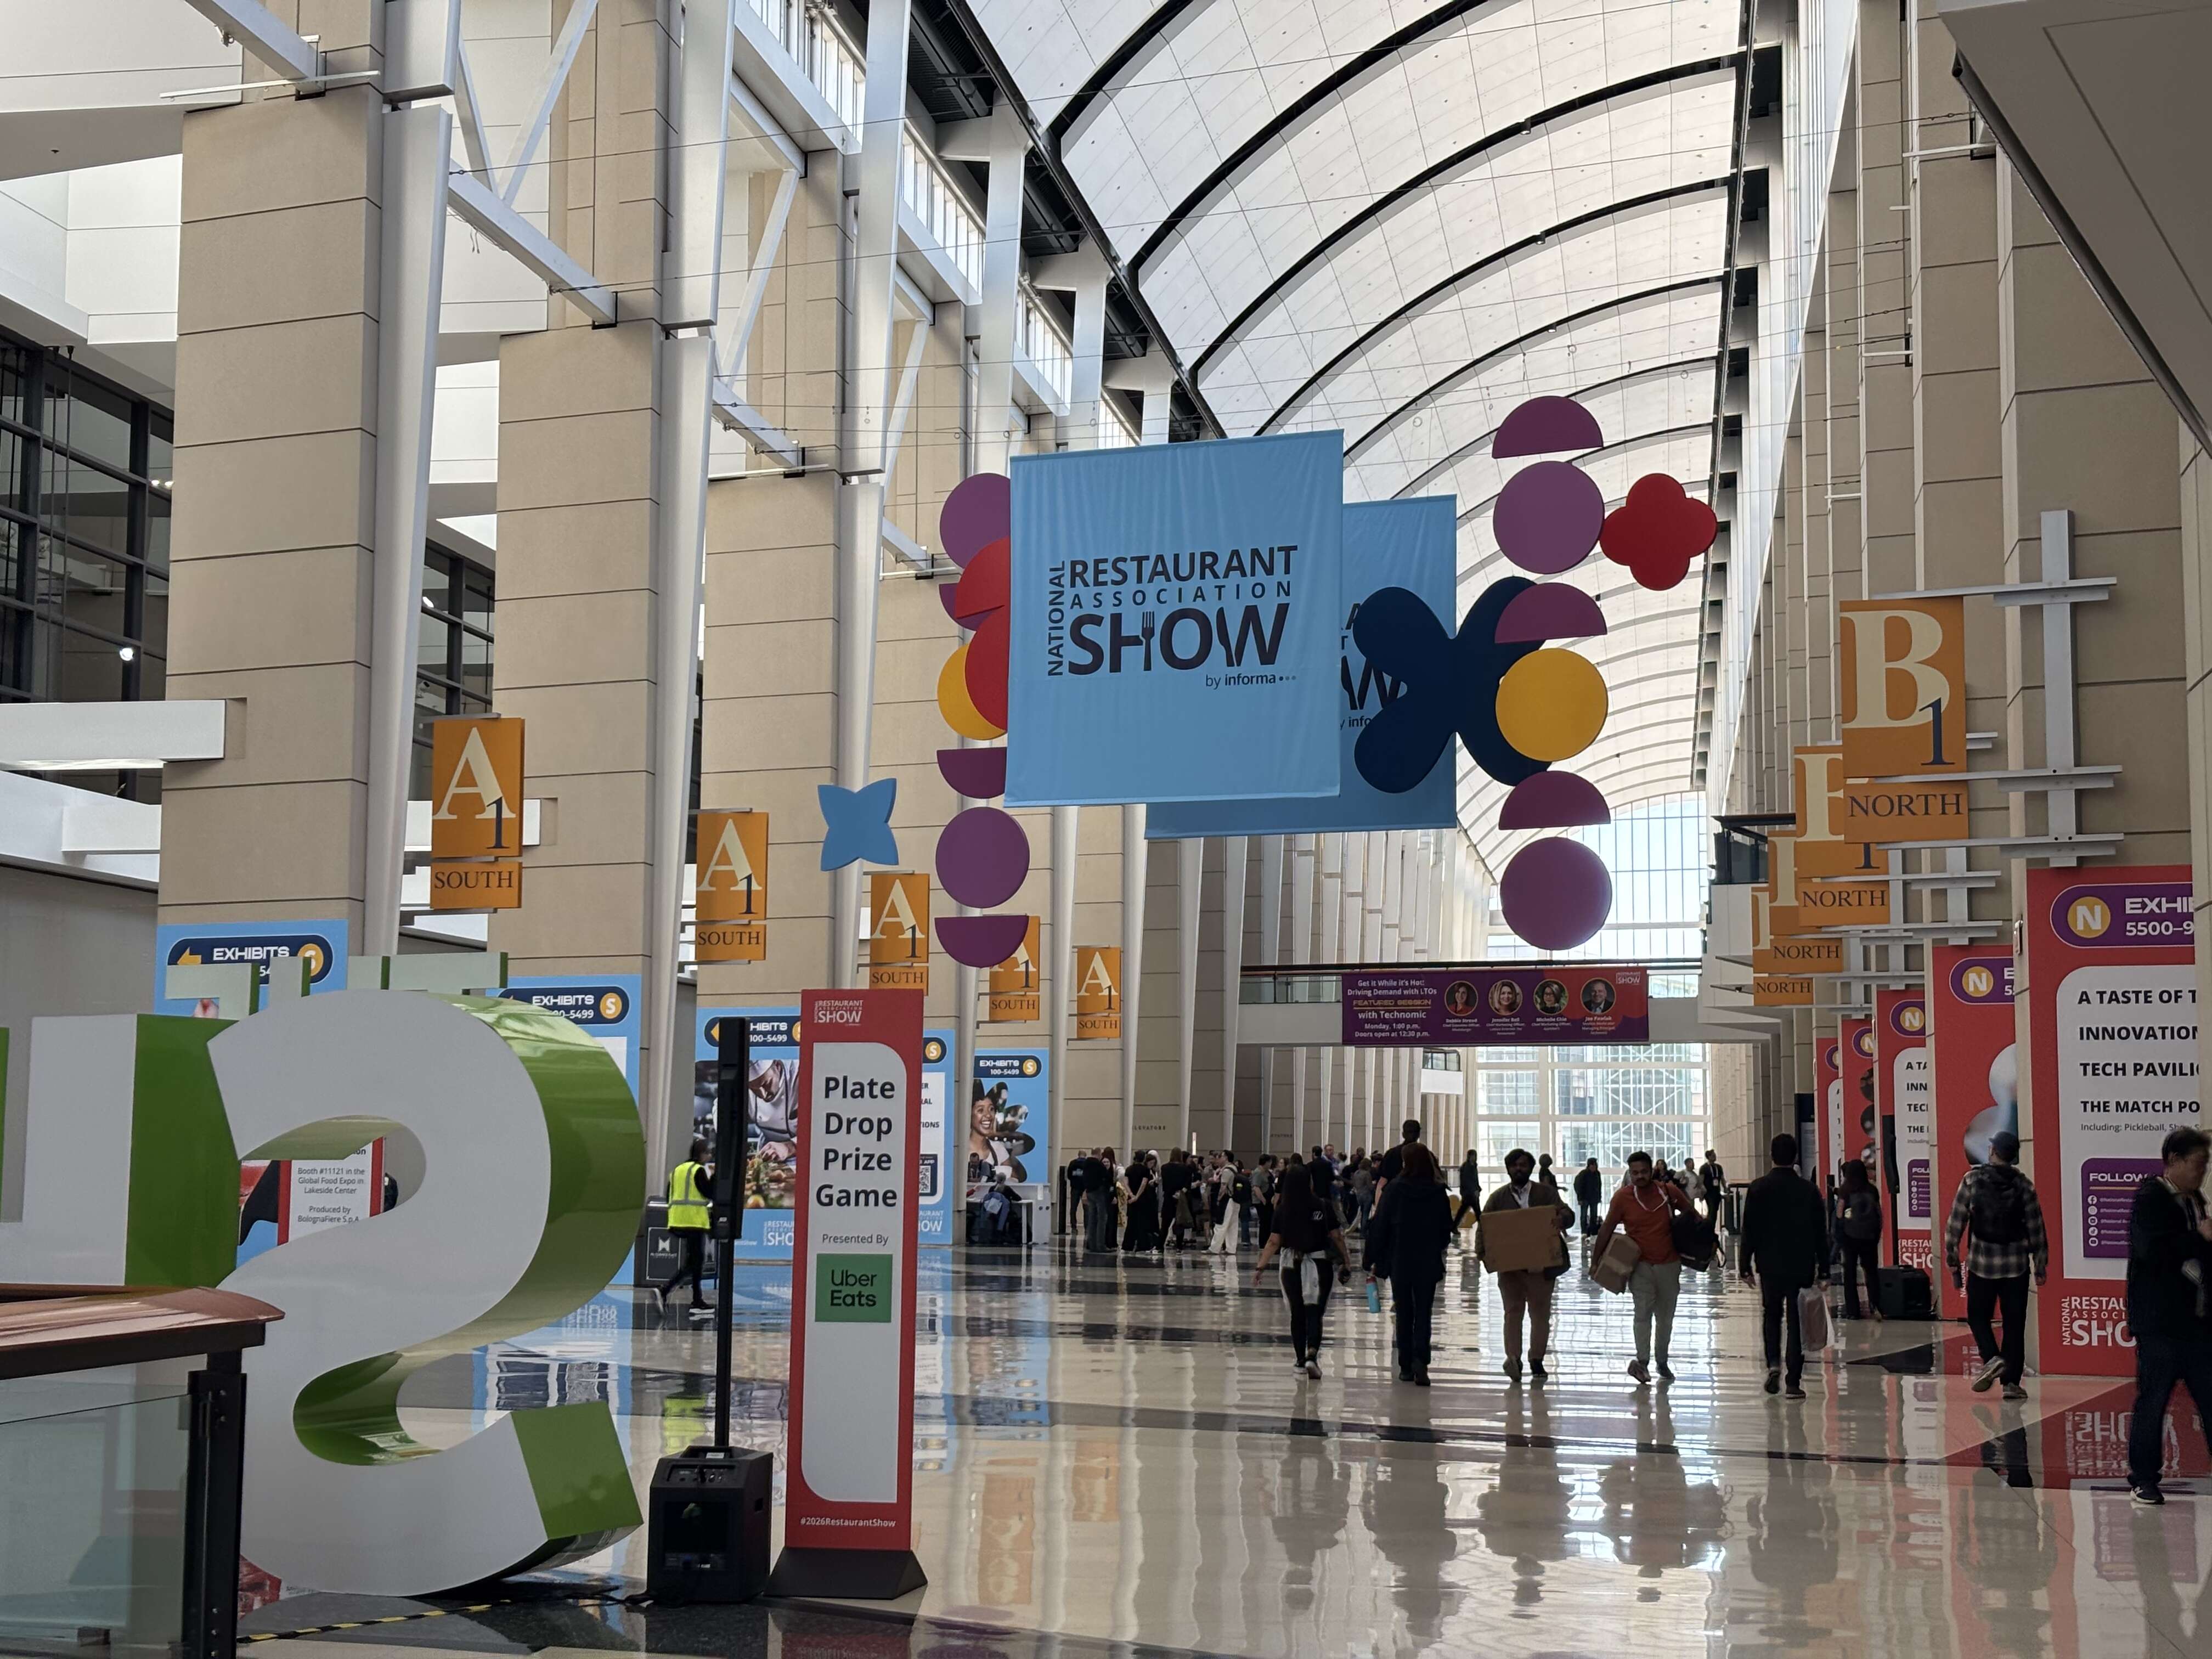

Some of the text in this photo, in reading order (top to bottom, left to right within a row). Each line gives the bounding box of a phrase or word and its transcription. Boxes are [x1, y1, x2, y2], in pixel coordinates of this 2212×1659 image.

[1070, 545, 1298, 588] RESTAURANT
[1070, 580, 1291, 610] ASSOCIATION
[1048, 561, 1065, 676] NATIONAL
[1068, 603, 1290, 676] SHOW
[1206, 673, 1276, 690] by informa
[1348, 716, 1372, 727] info
[1848, 793, 1965, 817] NORTH
[434, 871, 514, 889] SOUTH
[1803, 890, 1887, 907] NORTH
[2076, 897, 2194, 930] N EXHI
[2126, 921, 2194, 936] 5500-9
[698, 930, 760, 946] SOUTH
[213, 946, 290, 961] EXHIBITS
[1773, 945, 1839, 959] NORTH
[872, 972, 924, 984] SOUTH
[1968, 973, 1987, 992] N
[1756, 982, 1812, 994] NORTH
[532, 995, 616, 1014] EXHIBITS S
[991, 999, 1036, 1010] SOUTH
[2078, 991, 2091, 1005] A
[2096, 990, 2153, 1005] TASTE
[2158, 990, 2183, 1003] OF
[552, 1009, 594, 1019] 0-5499
[818, 1011, 862, 1023] SHOW
[1379, 1011, 1426, 1019] Technomic
[1905, 1012, 1920, 1027] N
[750, 1022, 788, 1031] HIBITS
[1079, 1019, 1118, 1030] SOUTH
[749, 1034, 787, 1042] 100-5499
[929, 1045, 937, 1057] S
[1905, 1062, 1914, 1070] A
[2080, 1062, 2199, 1076] TECH PAVILI
[825, 1075, 895, 1099] Plate
[2080, 1101, 2111, 1113] THE
[2115, 1101, 2173, 1113] MATCH
[825, 1112, 893, 1142] Drop
[2081, 1124, 2122, 1132] Including:
[2124, 1124, 2166, 1132] Pickleball,
[823, 1147, 892, 1171] Prize
[816, 1184, 897, 1207] Game
[342, 1206, 351, 1215] by
[298, 1215, 341, 1224] BolognaFiere
[918, 1220, 943, 1232] OW
[768, 1232, 794, 1246] SHO
[822, 1233, 889, 1246] Presented By
[1902, 1253, 1933, 1268] SHO
[831, 1269, 877, 1286] Uber
[830, 1290, 877, 1307] Eats
[2072, 1296, 2127, 1310] RESTAU
[2062, 1296, 2070, 1345] NATIONAL
[2072, 1311, 2126, 1319] ASSOCI
[2072, 1319, 2137, 1347] SHO
[800, 1517, 896, 1527] #2026RestaurantShow
